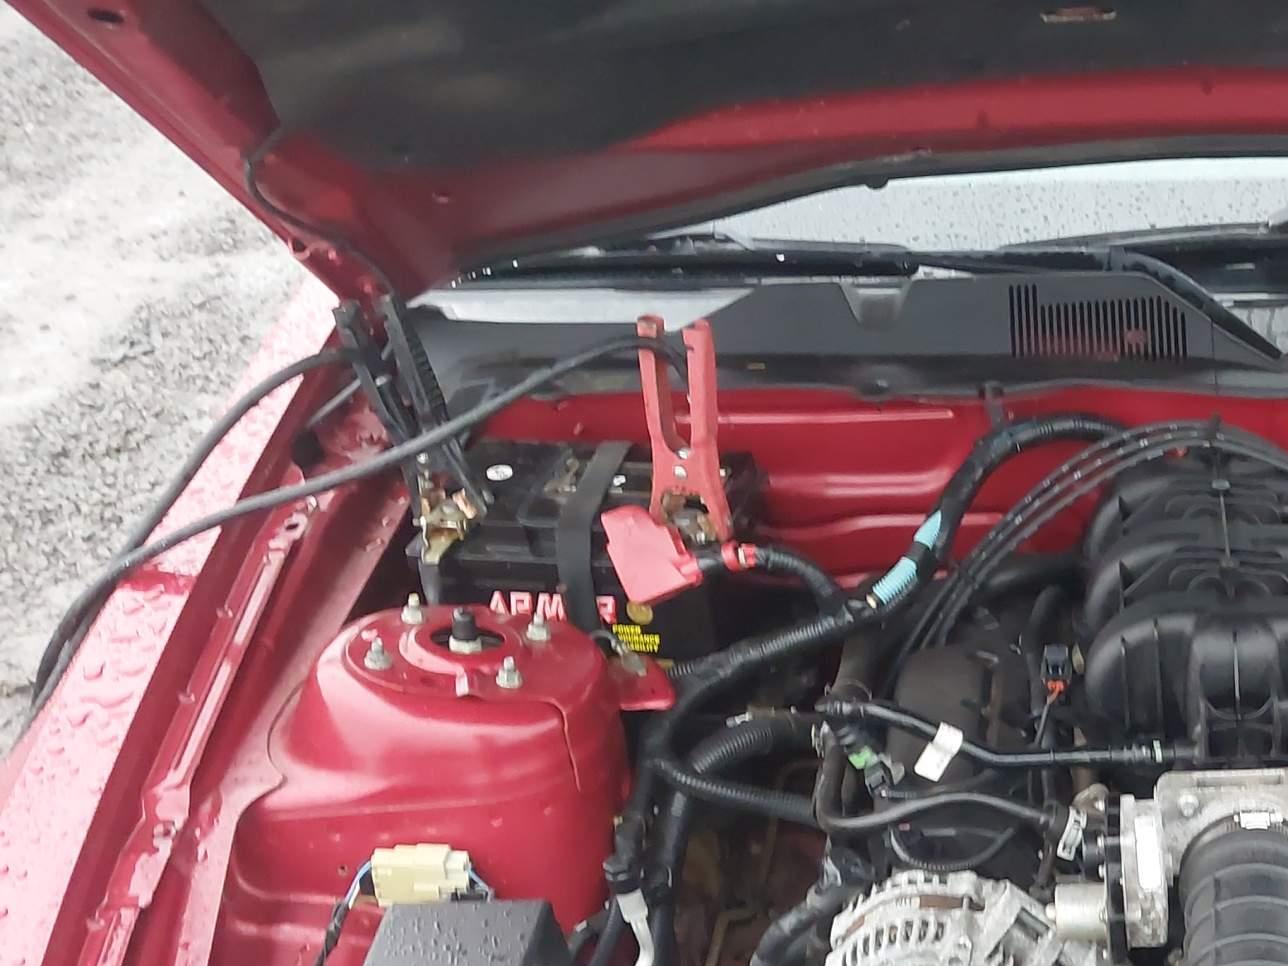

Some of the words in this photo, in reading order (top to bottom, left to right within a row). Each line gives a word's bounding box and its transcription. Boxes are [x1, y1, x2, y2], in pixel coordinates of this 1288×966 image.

[490, 590, 617, 624] ARMR
[612, 624, 641, 634] POWER
[617, 633, 660, 644] NDURANCE
